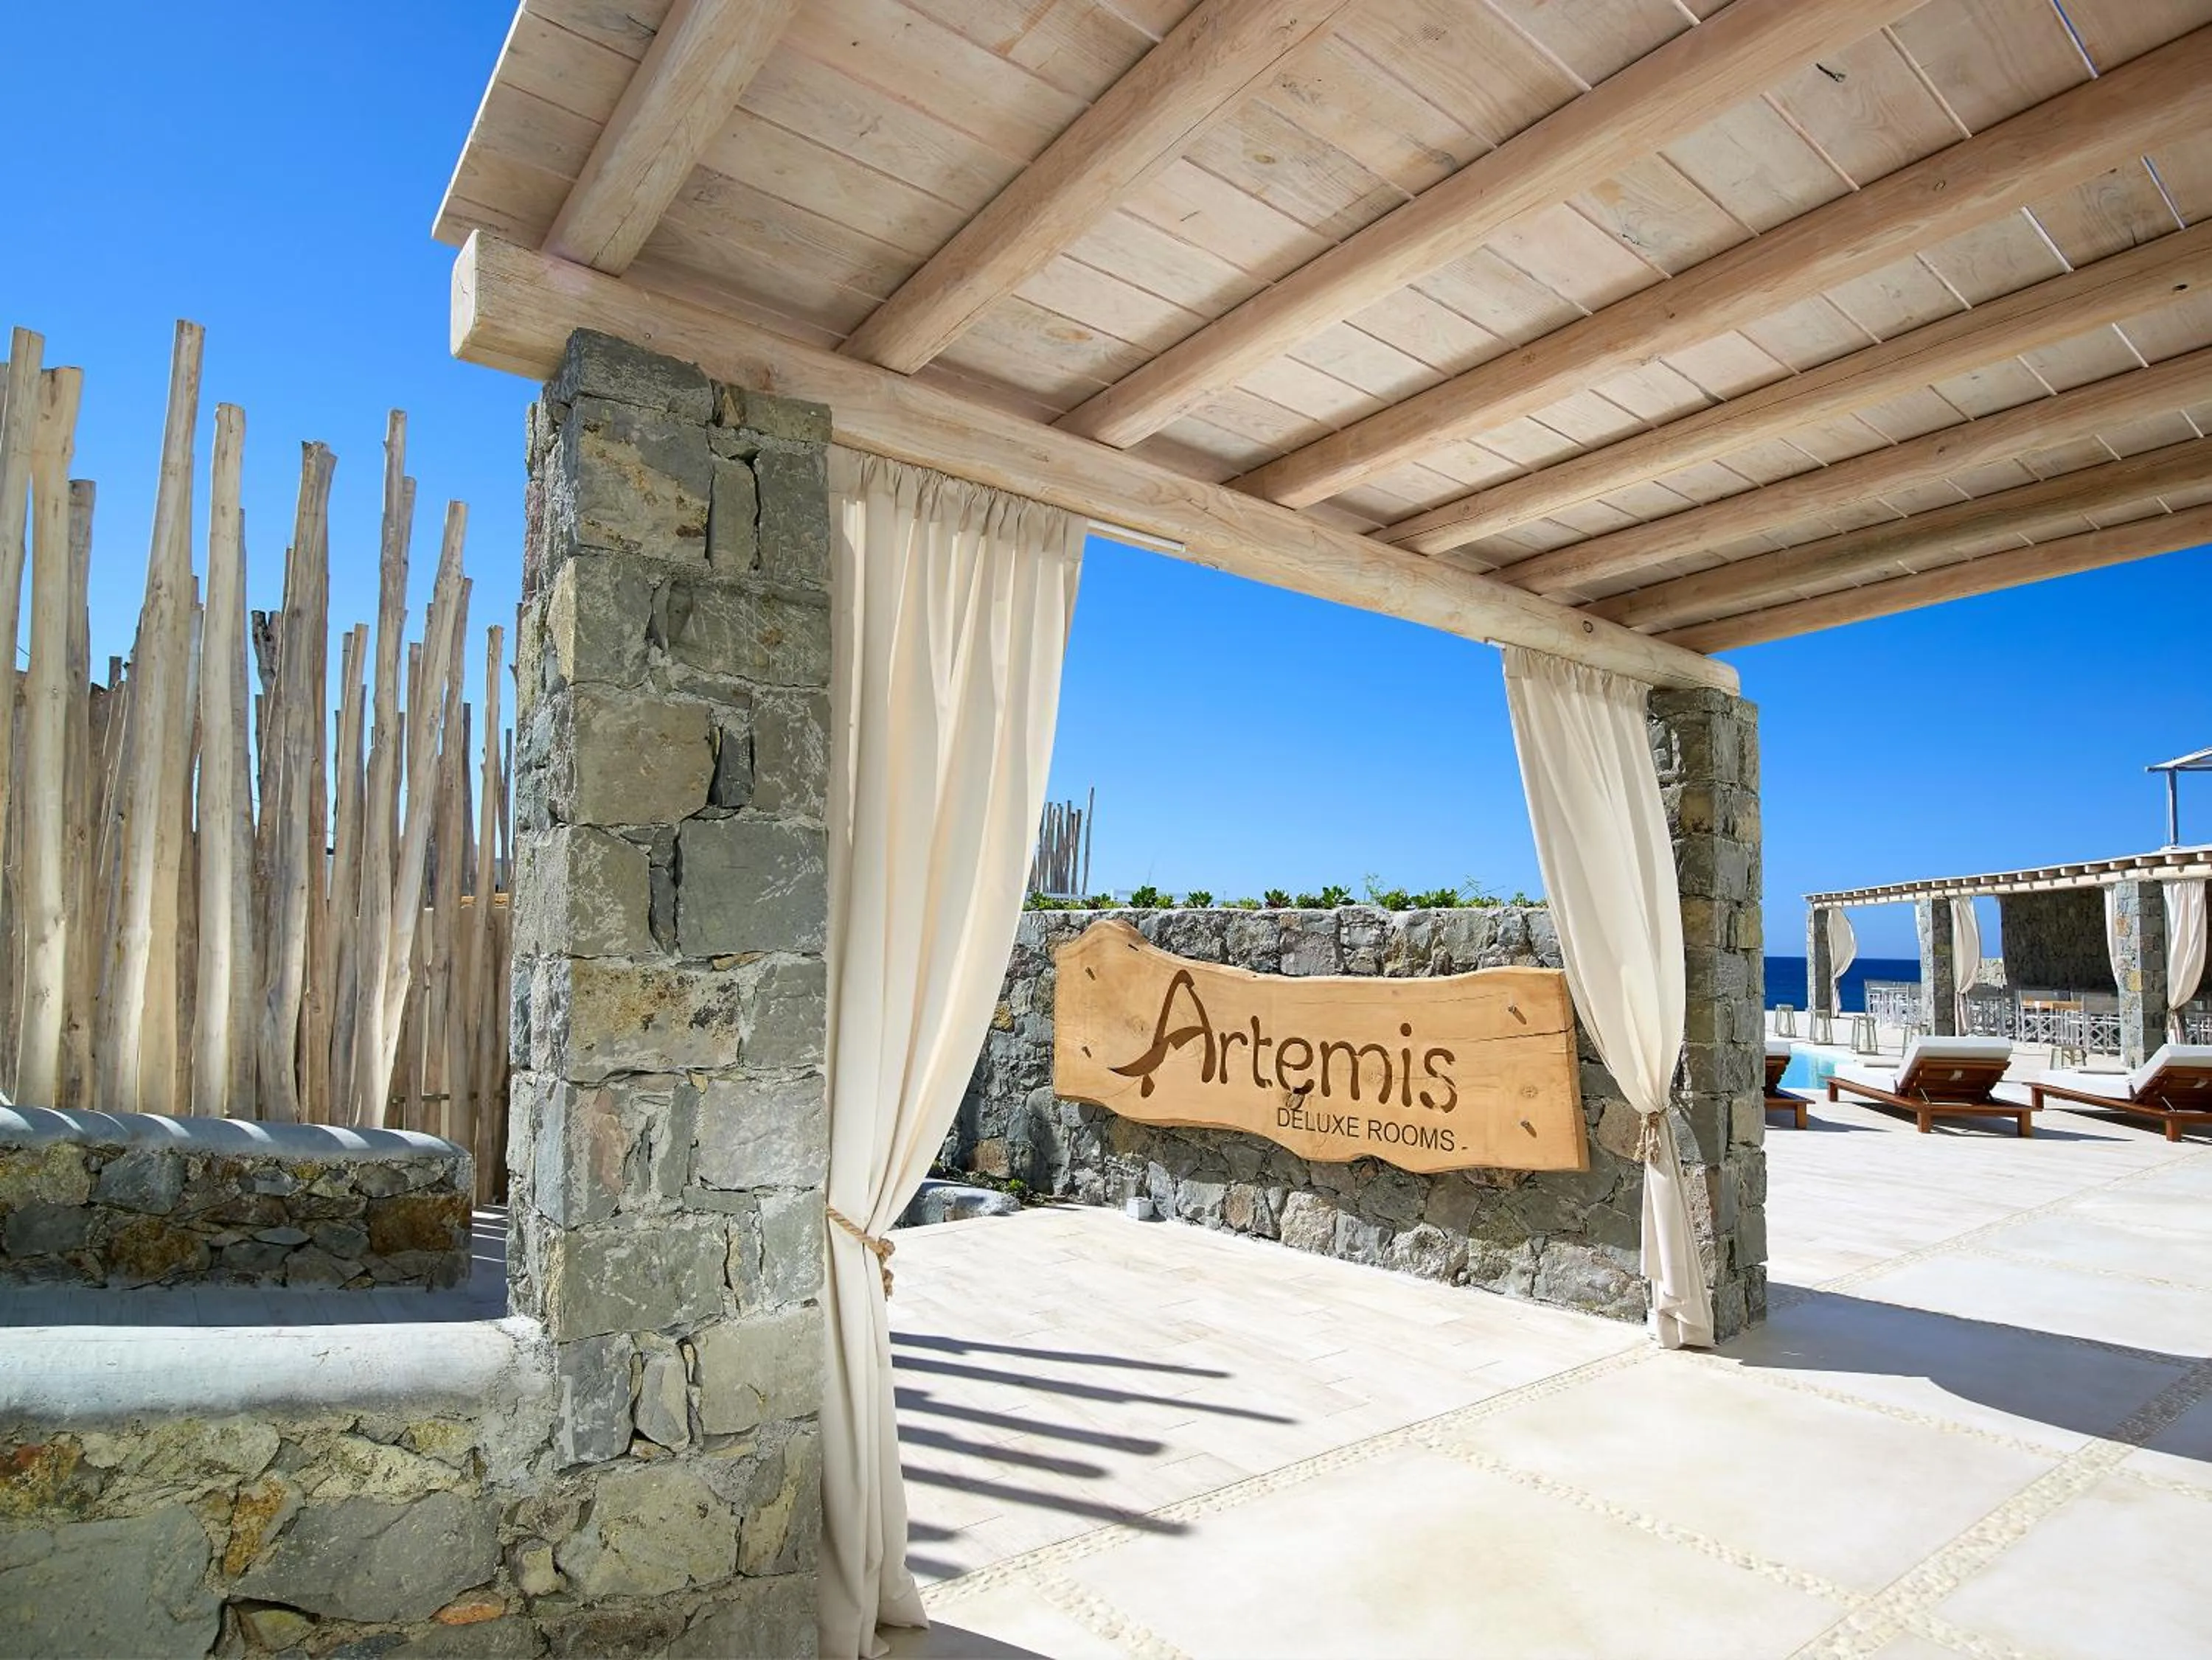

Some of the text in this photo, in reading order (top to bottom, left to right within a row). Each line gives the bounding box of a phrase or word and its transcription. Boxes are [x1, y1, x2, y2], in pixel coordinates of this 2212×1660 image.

[1108, 969, 1458, 1113] Artemis
[1277, 1107, 1455, 1151] DELUXE ROOMS
